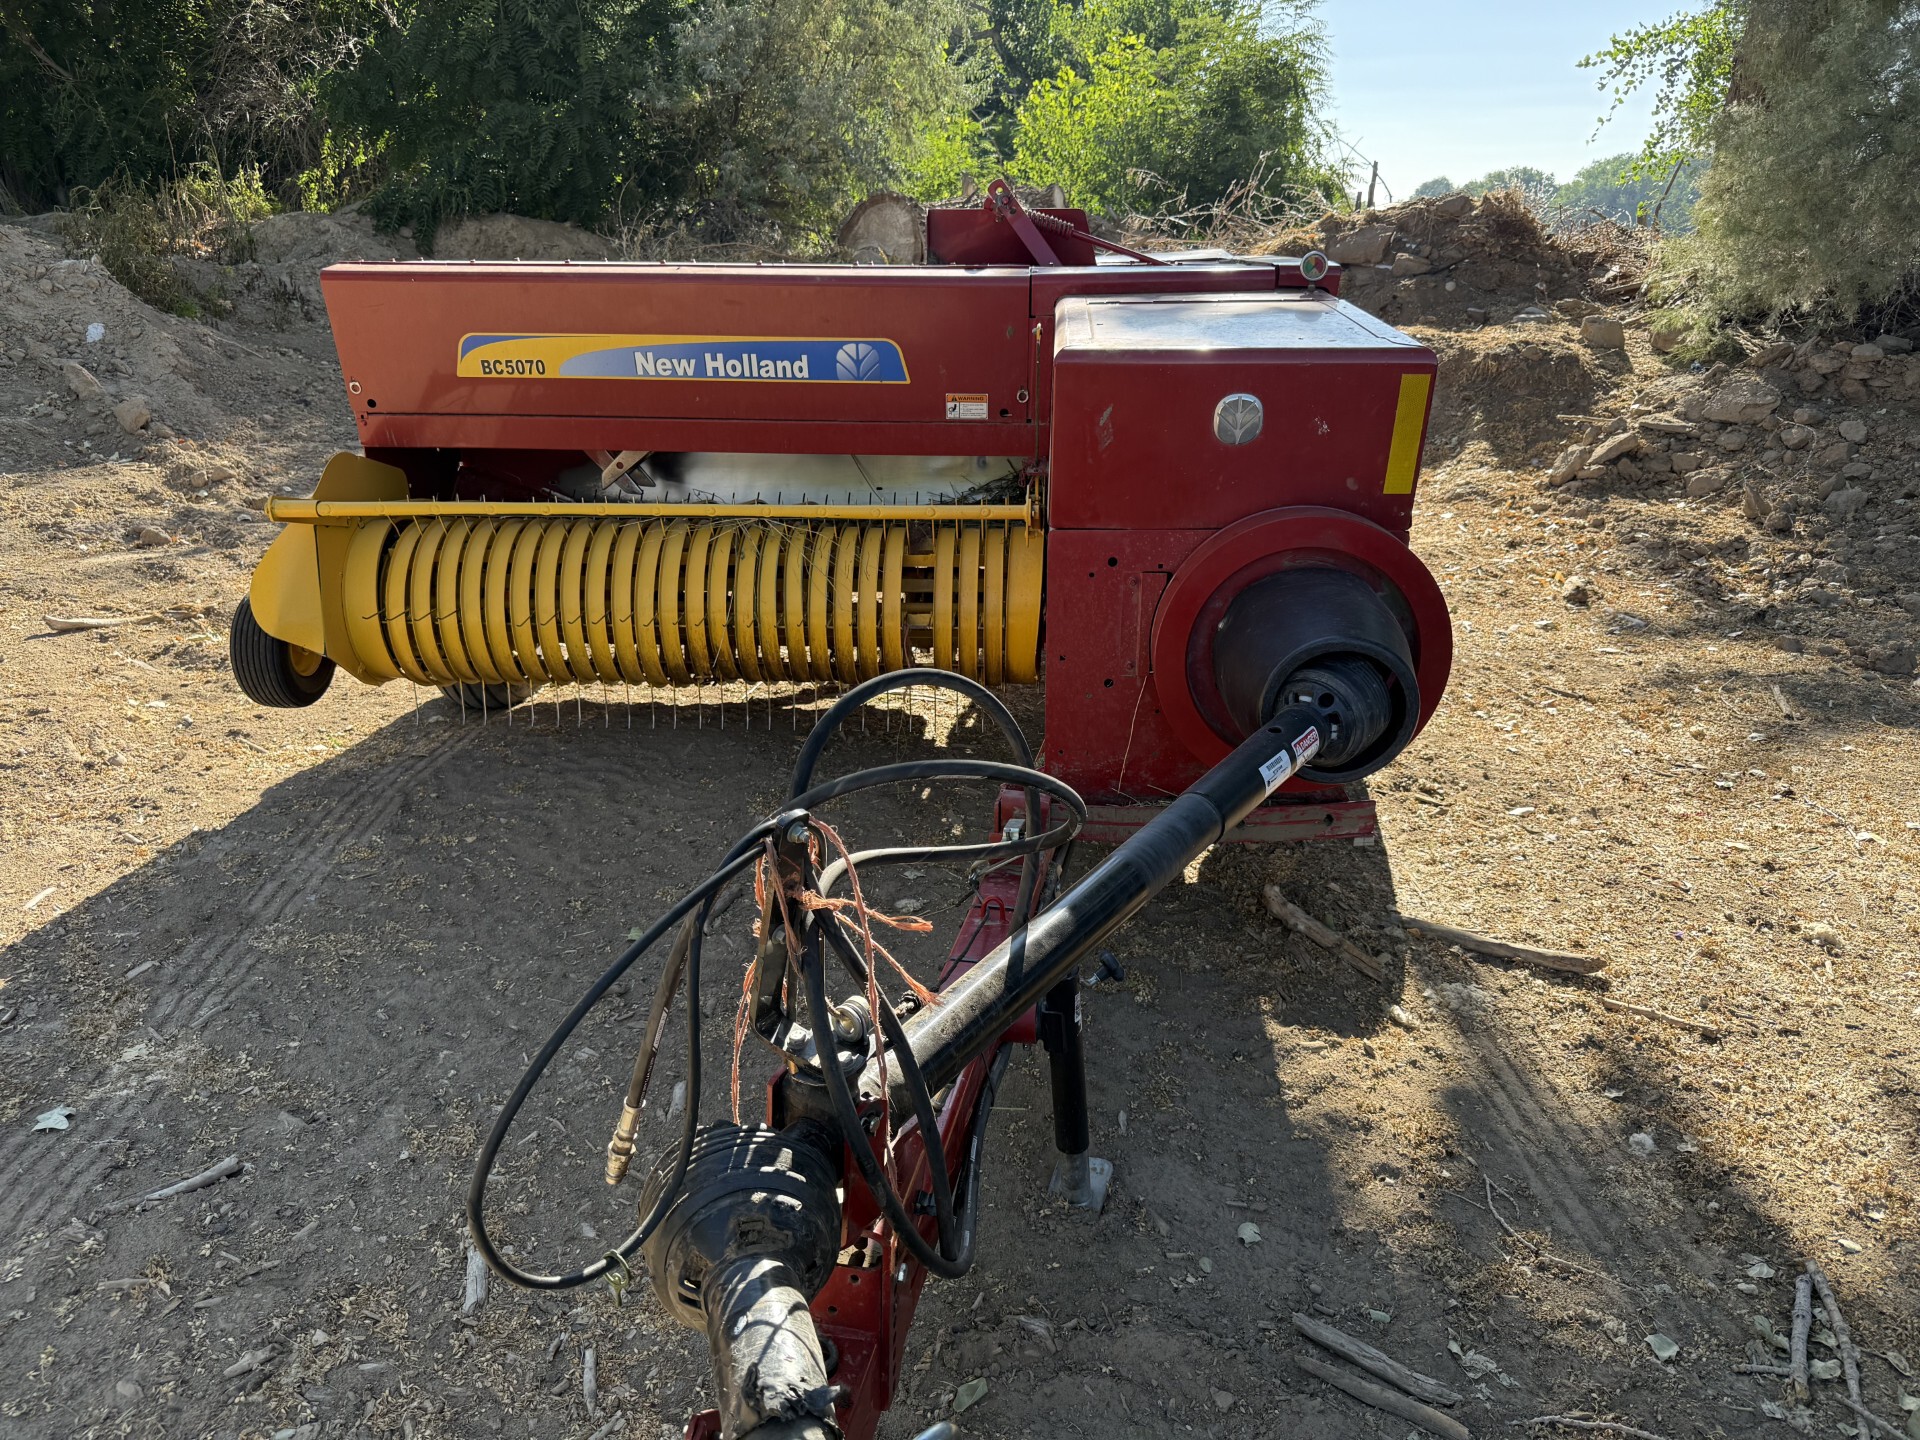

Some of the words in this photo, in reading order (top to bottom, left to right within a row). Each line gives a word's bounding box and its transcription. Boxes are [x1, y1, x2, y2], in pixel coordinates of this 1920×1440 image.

[480, 359, 546, 375] BC5070
[634, 351, 696, 376] New
[704, 352, 809, 379] Holland
[1300, 731, 1318, 750] DANGER
